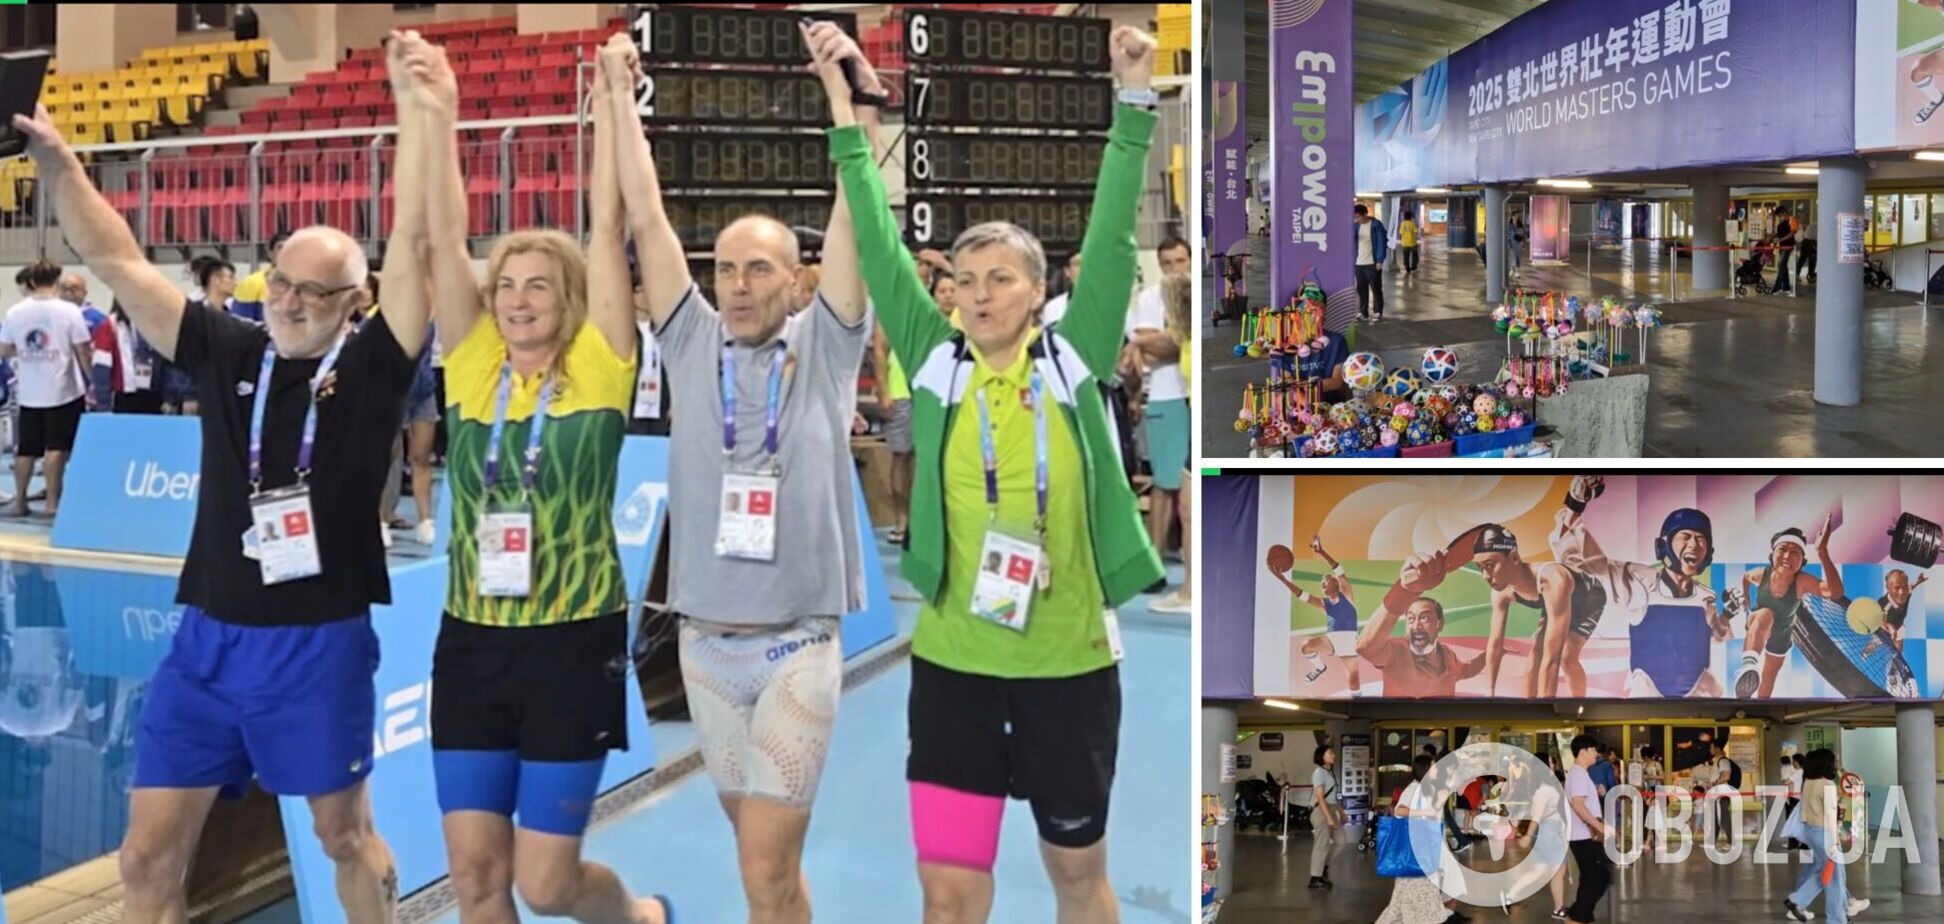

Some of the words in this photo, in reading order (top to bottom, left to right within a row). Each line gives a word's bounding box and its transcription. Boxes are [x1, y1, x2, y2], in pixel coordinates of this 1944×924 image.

[634, 11, 651, 53] 1
[910, 15, 929, 54] 6
[1468, 74, 1503, 117] 2025
[1506, 0, 1731, 106] 雙北世界壯年運動會
[637, 75, 655, 116] 2
[914, 78, 930, 118] 7
[1505, 102, 1551, 135] WORLD
[1555, 78, 1636, 124] MASTERS
[1643, 51, 1732, 105] GAMES
[913, 139, 929, 180] 8
[1292, 50, 1336, 253] Empower
[912, 202, 932, 243] 9
[1292, 208, 1302, 244] TAIPEI
[124, 461, 200, 500] Uber
